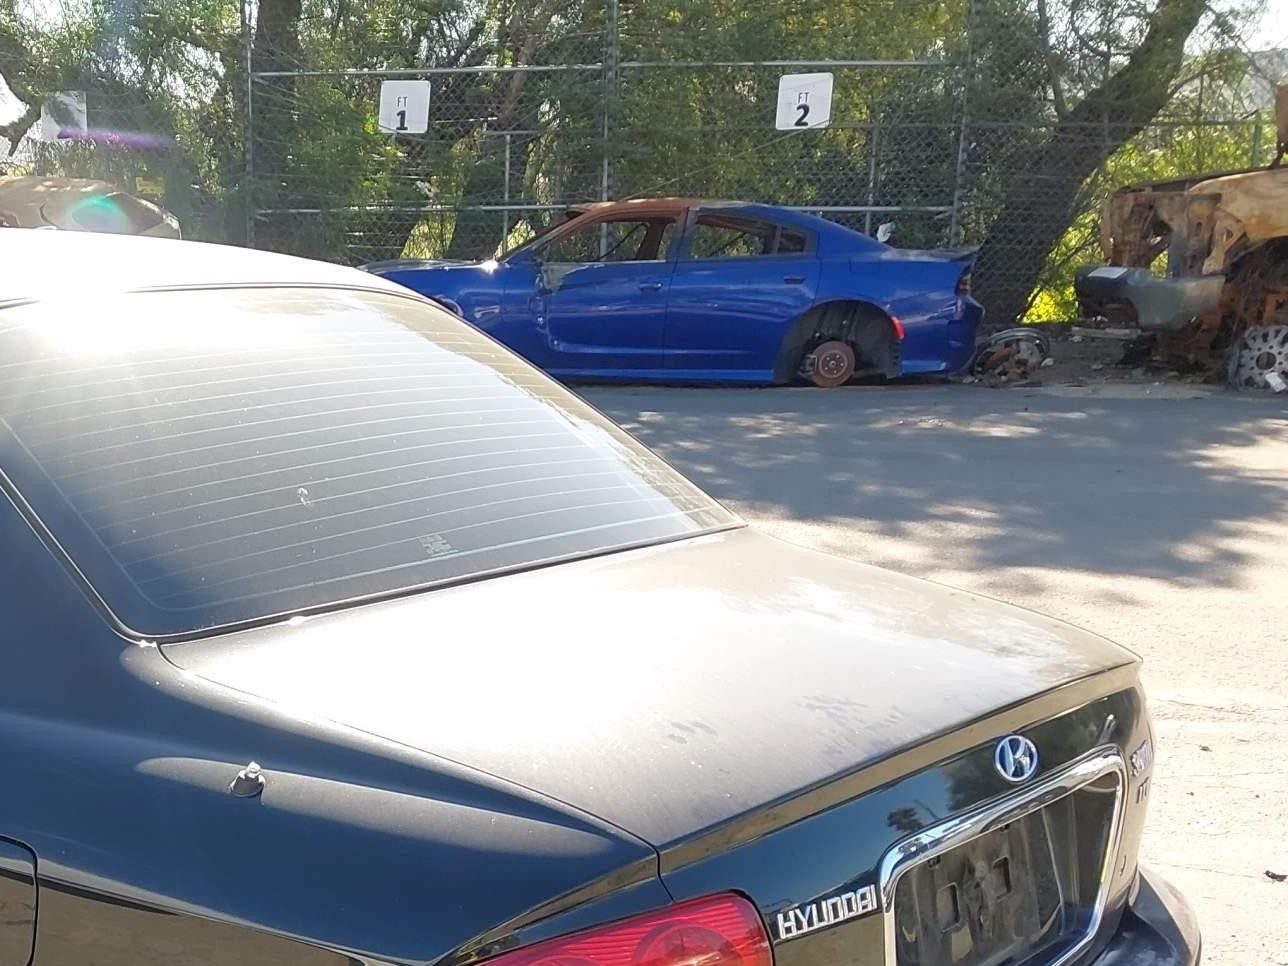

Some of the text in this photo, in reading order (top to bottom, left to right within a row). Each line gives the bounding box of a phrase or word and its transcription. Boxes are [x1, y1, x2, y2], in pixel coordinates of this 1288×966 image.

[397, 96, 408, 107] FT
[798, 91, 809, 103] FT
[396, 110, 408, 131] 1
[794, 103, 810, 127] 2
[776, 883, 878, 940] HYUNDAI
